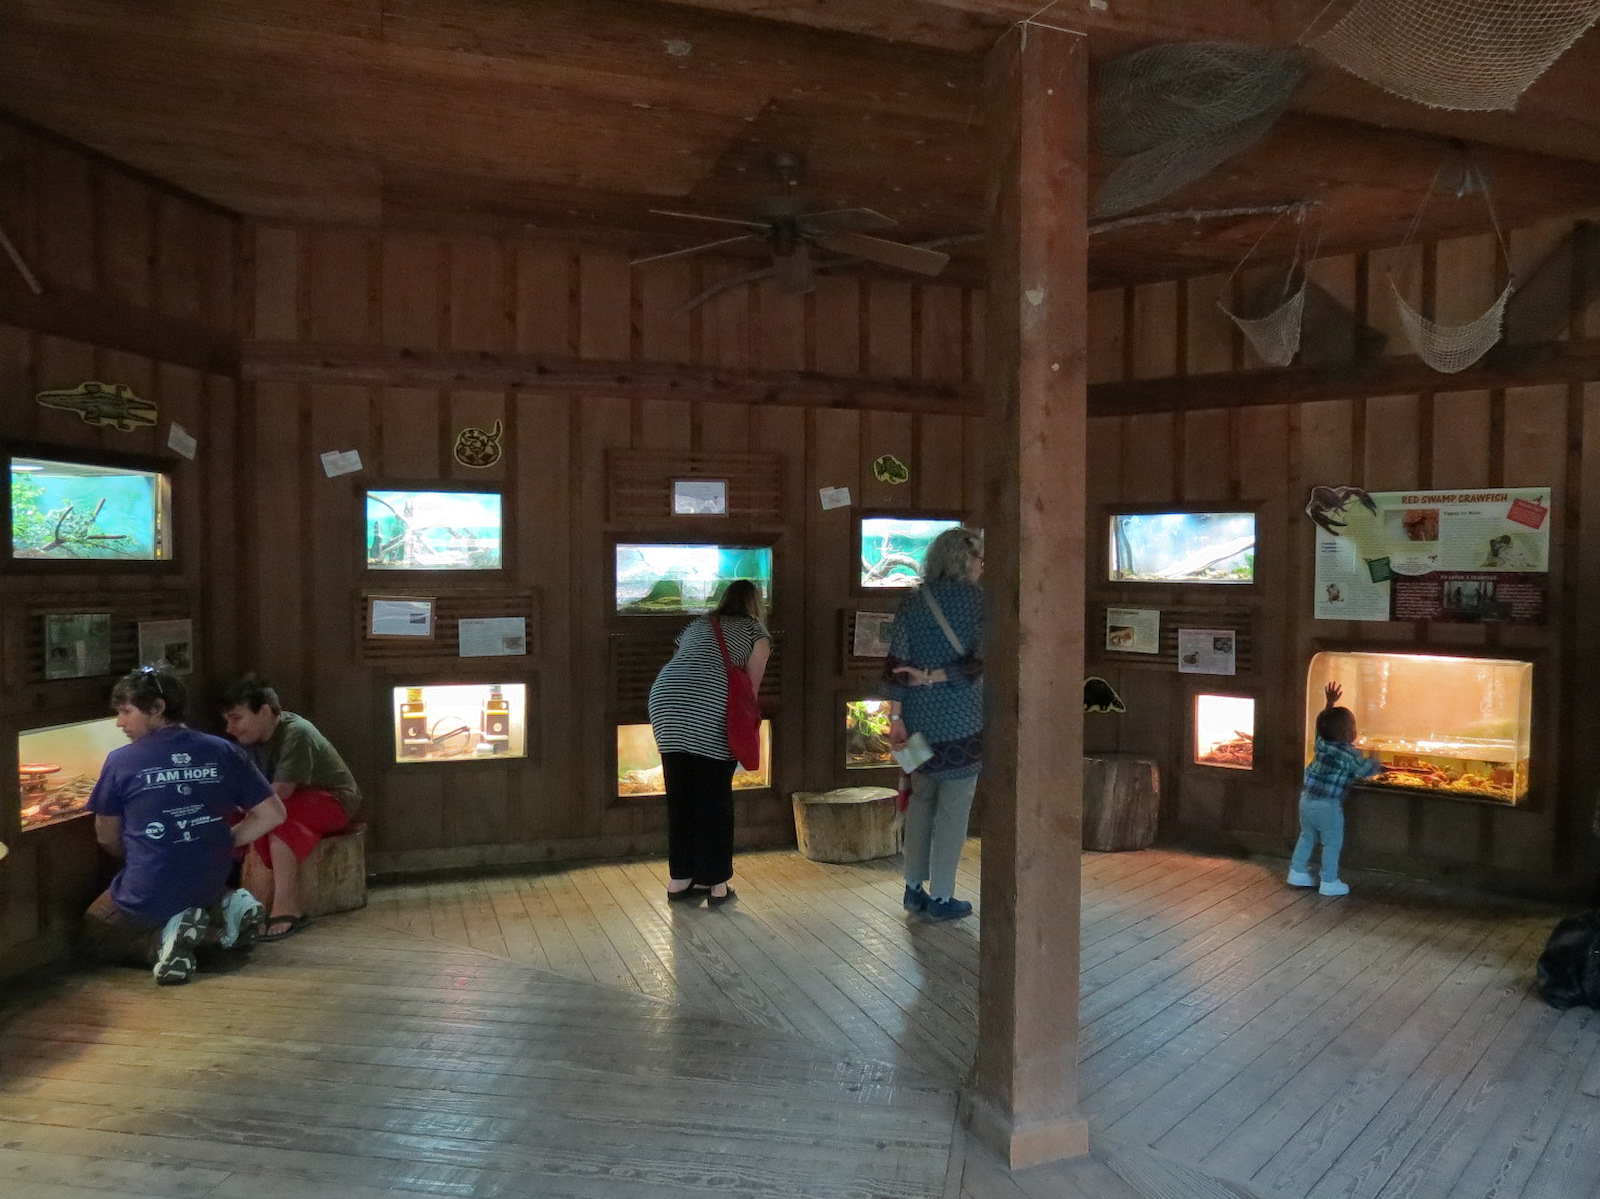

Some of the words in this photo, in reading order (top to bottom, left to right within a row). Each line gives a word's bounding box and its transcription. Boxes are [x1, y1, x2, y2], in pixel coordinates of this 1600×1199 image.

[1402, 496, 1418, 504] RED
[1421, 495, 1456, 503] SWAMP
[1459, 493, 1508, 503] CRAWFISH
[146, 774, 151, 784] I
[155, 771, 180, 783] AM
[184, 768, 218, 779] HOPE
